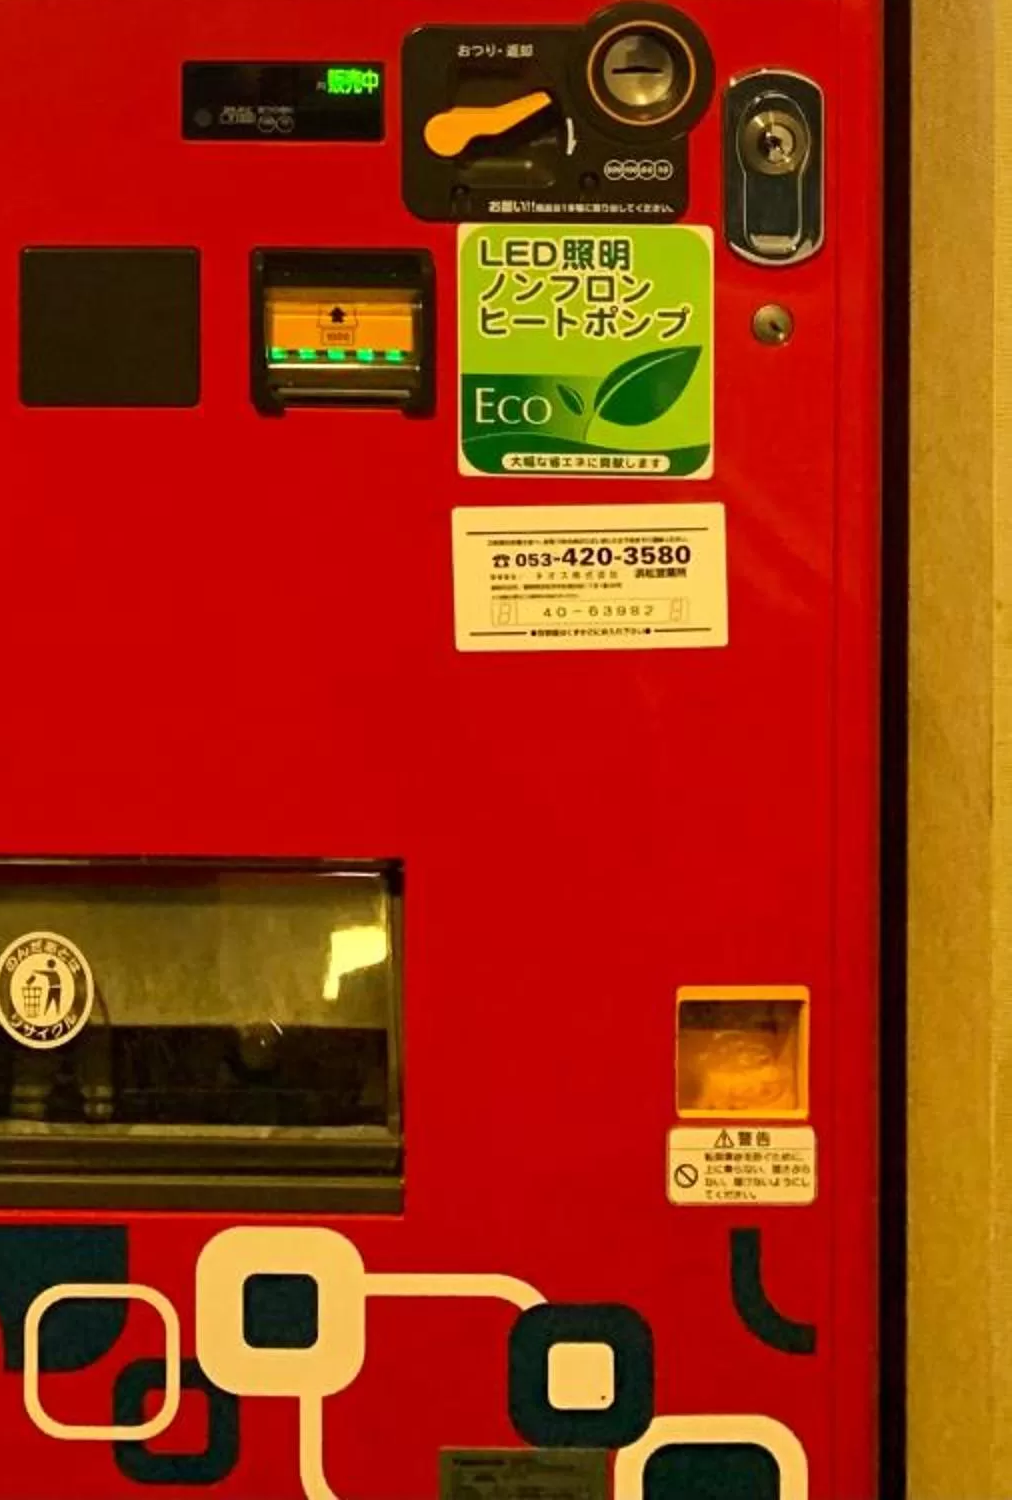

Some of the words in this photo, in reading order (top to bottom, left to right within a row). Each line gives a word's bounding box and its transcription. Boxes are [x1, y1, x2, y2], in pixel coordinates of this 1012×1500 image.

[480, 239, 632, 271] LED照明
[480, 272, 653, 304] ノンフロン
[480, 305, 691, 339] ヒートポンプ
[515, 545, 692, 568] 053-420-3580
[10, 1012, 79, 1041] リサイクル
[737, 1131, 772, 1148] 警告
